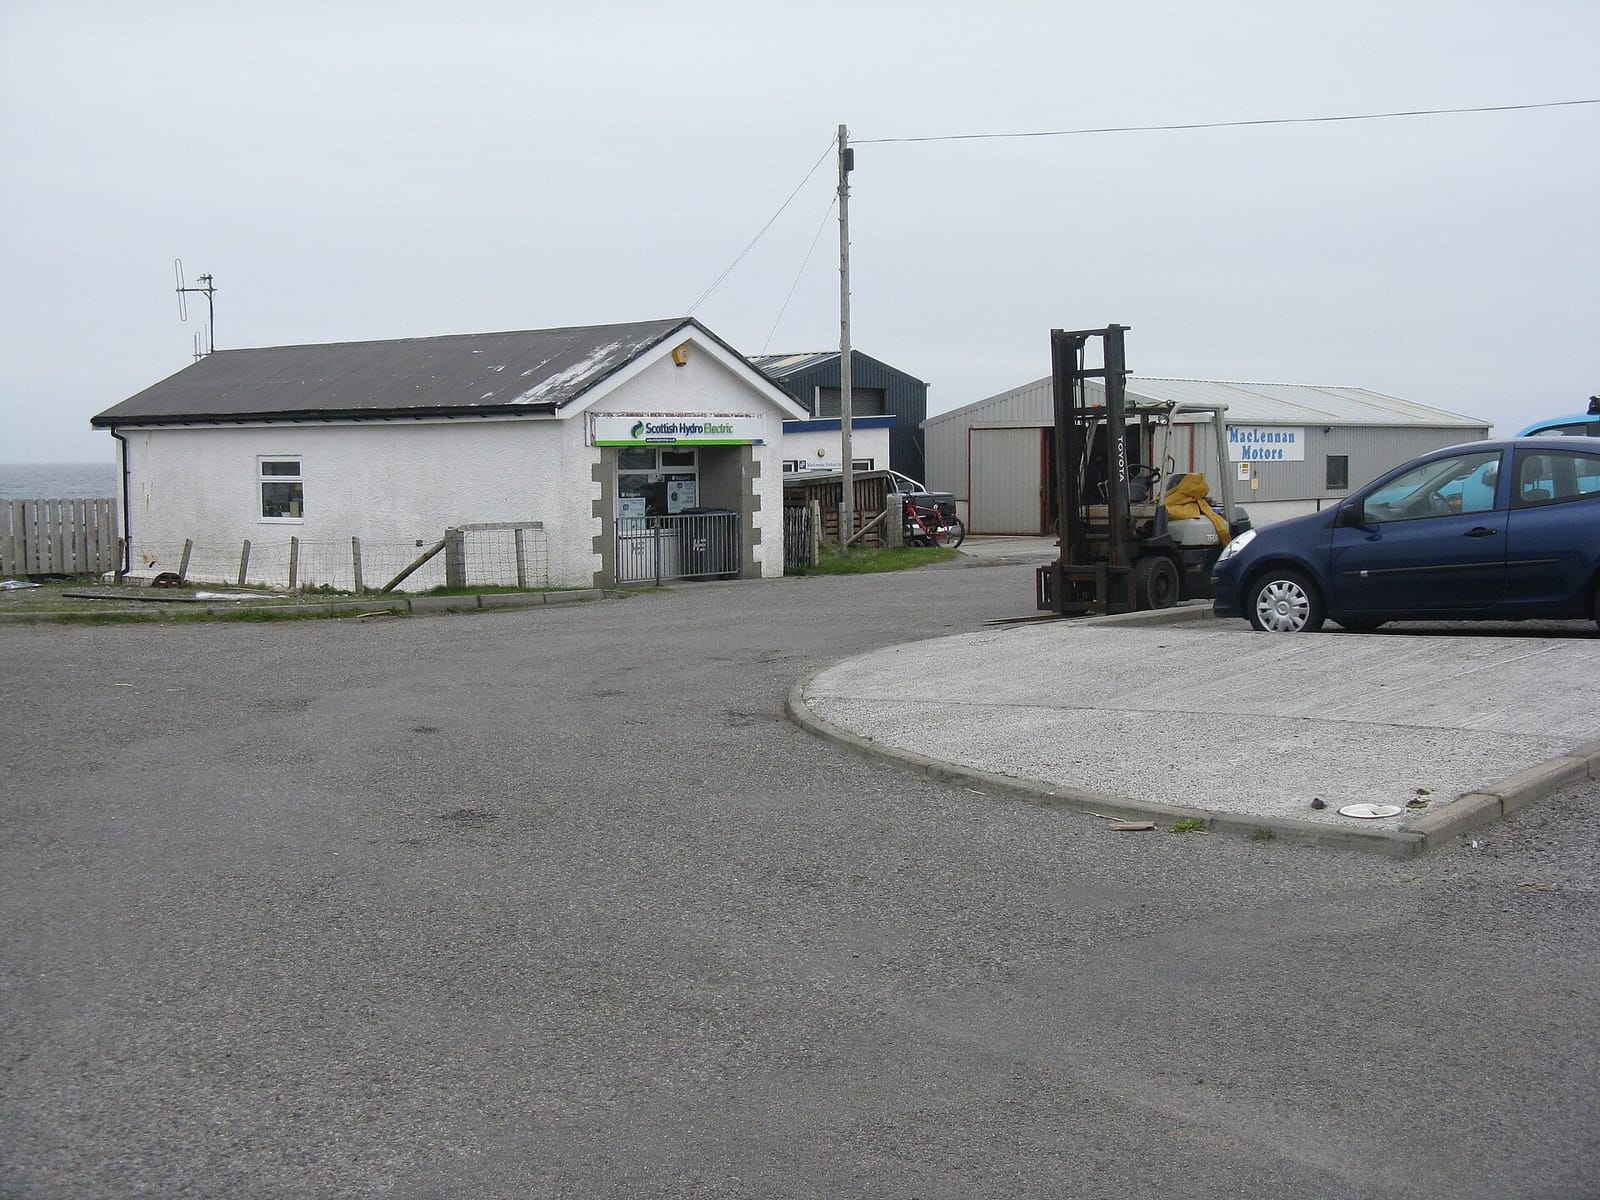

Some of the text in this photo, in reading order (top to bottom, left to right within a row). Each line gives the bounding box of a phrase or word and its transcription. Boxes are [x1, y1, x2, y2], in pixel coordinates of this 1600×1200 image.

[645, 422, 734, 437] Scottish Hydro Electric
[1230, 427, 1295, 443] MacLennan
[1117, 435, 1125, 482] TOYOTA
[1242, 445, 1283, 460] Motors
